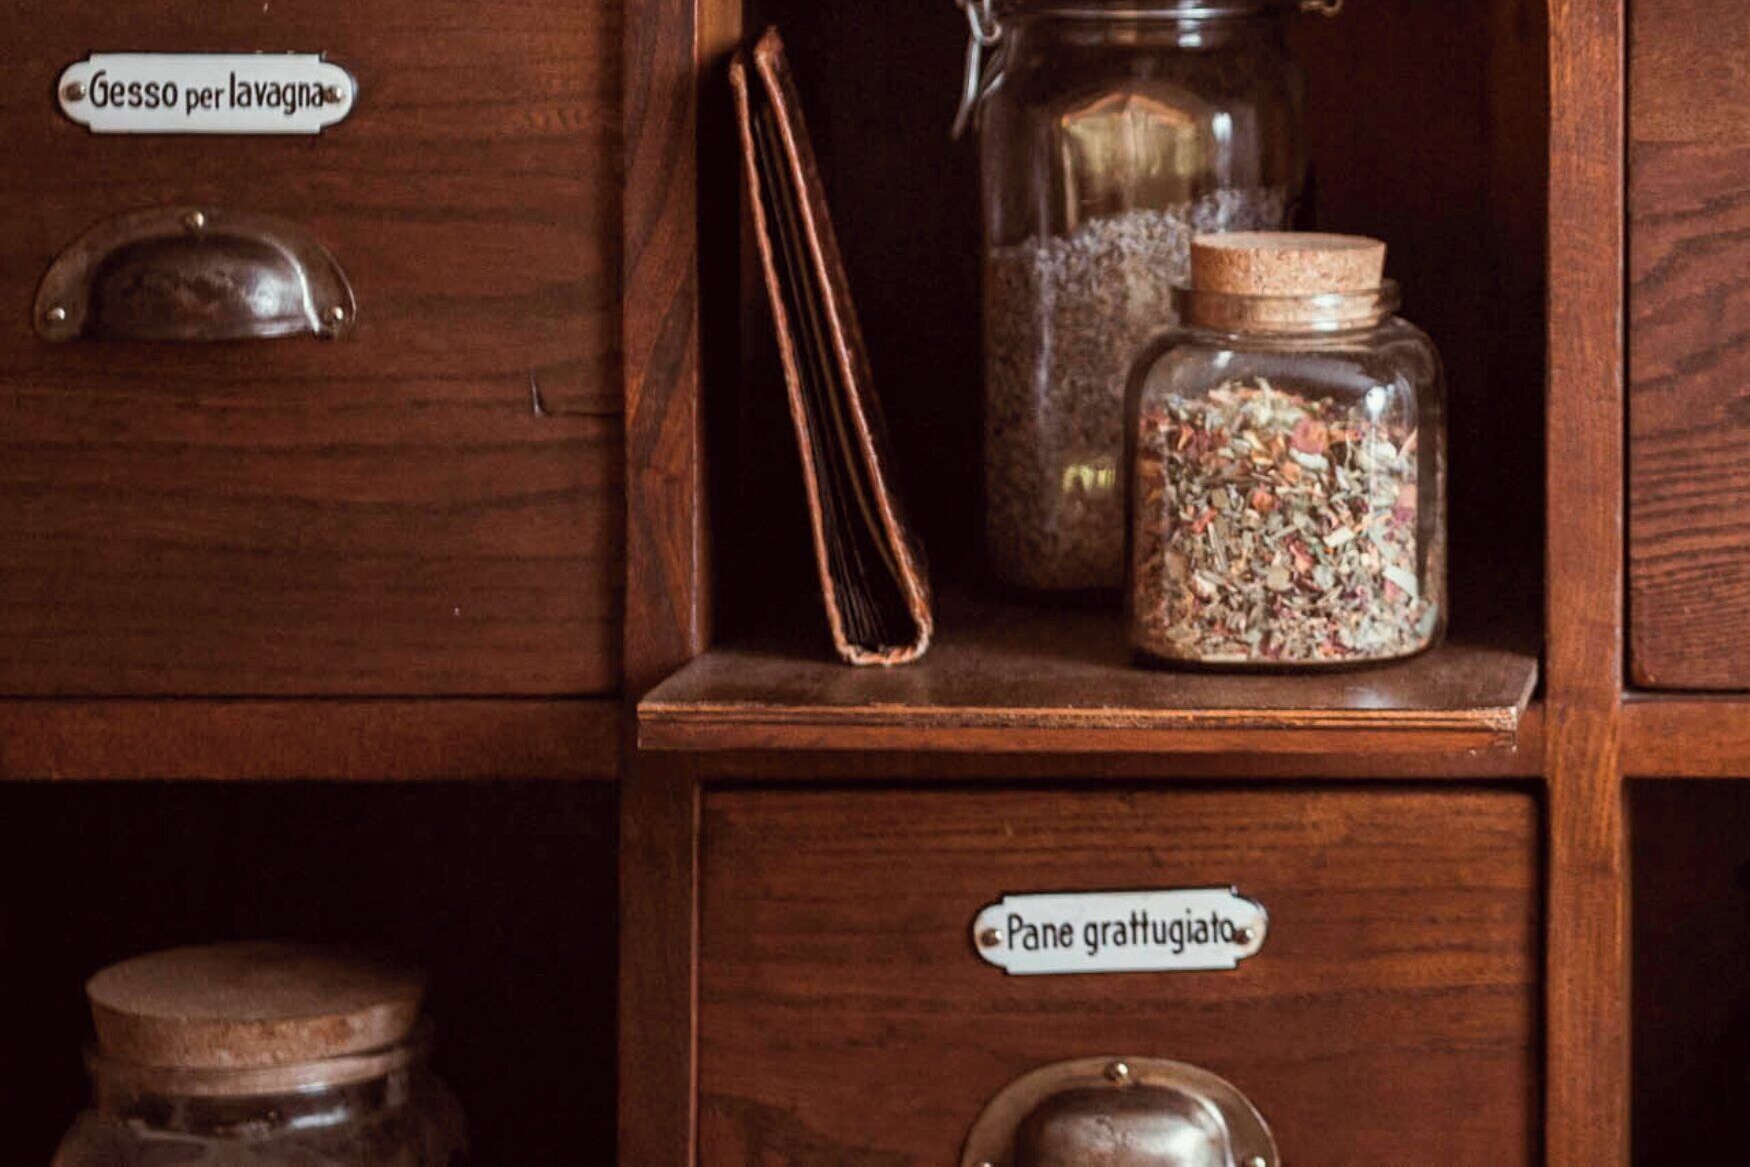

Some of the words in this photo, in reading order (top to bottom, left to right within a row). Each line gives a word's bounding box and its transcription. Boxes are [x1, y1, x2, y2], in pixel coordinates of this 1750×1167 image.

[89, 69, 178, 109] Gesso
[186, 85, 225, 115] per
[229, 71, 324, 114] lavagna
[1007, 912, 1073, 950] Pane
[1084, 908, 1236, 956] grattugiato
